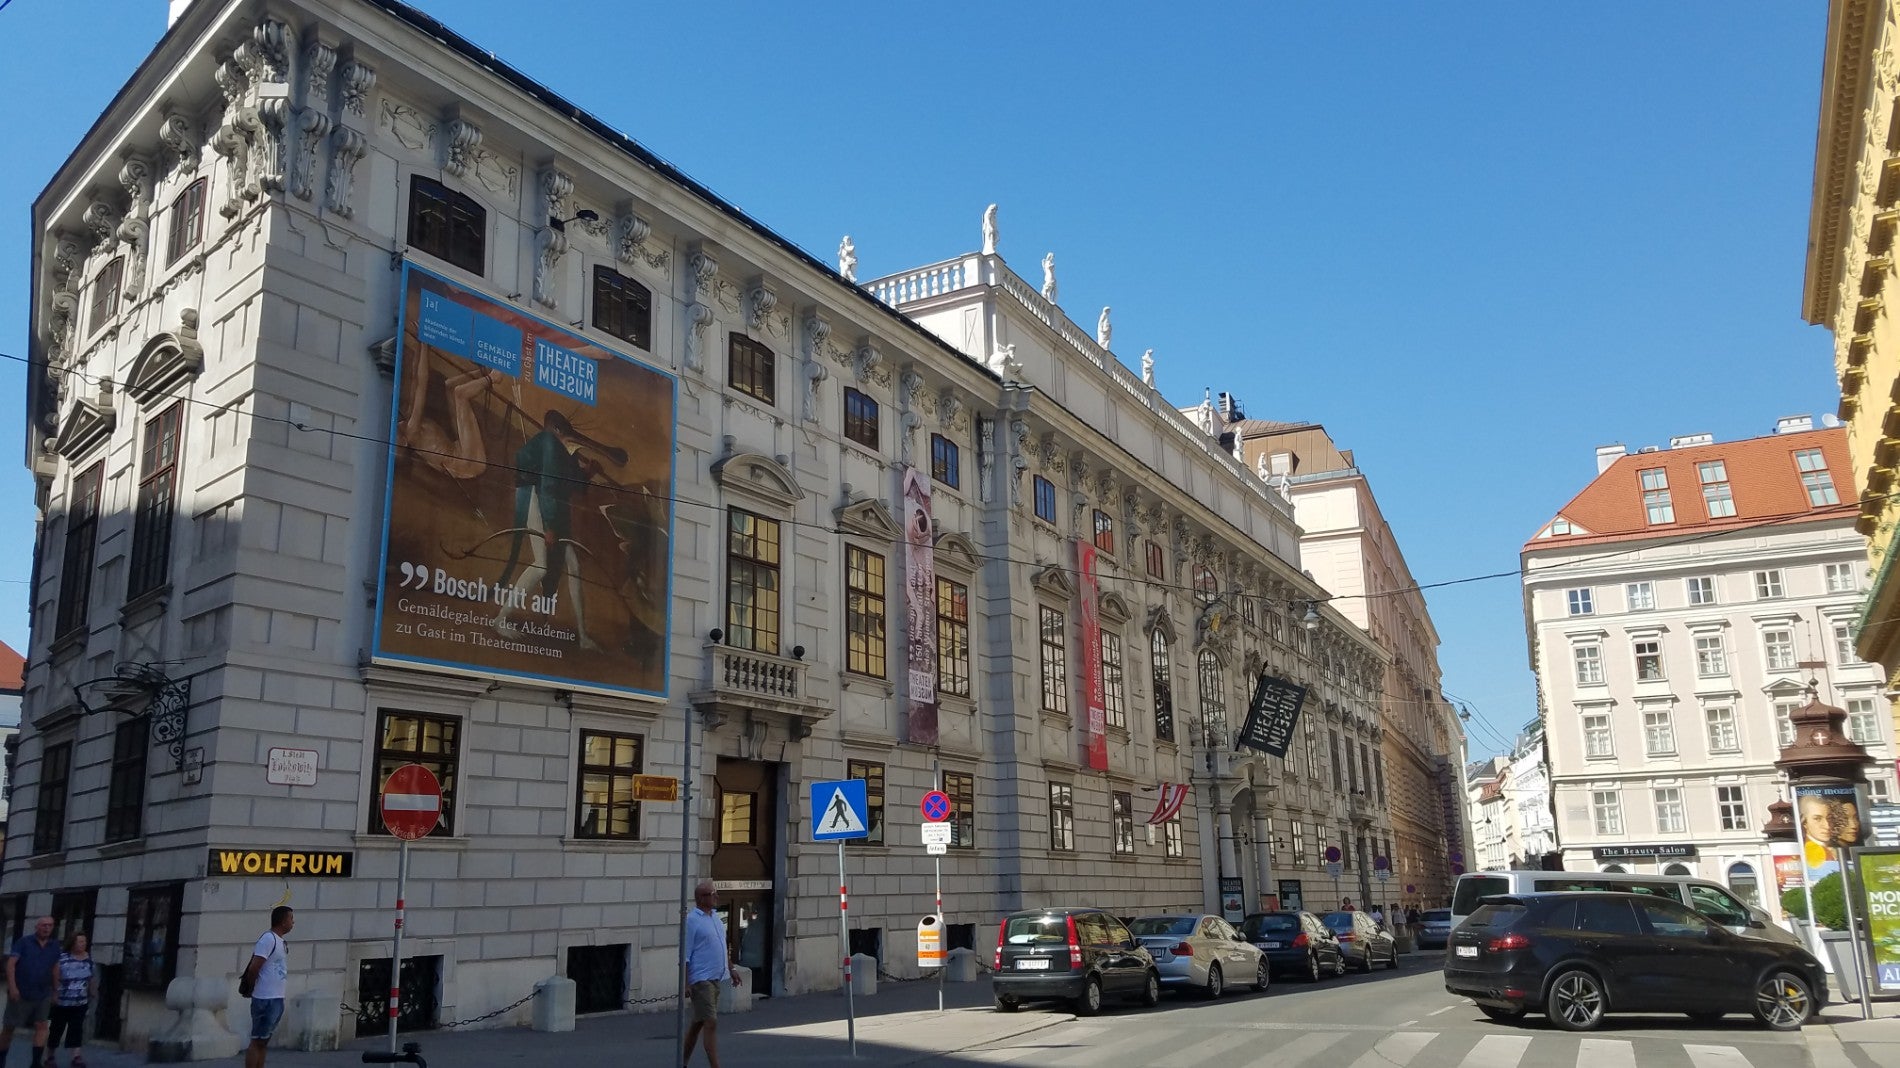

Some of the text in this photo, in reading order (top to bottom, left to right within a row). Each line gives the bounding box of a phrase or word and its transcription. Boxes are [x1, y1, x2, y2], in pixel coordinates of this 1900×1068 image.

[477, 350, 512, 370] GALERIE
[538, 343, 594, 382] THEATER
[434, 568, 488, 603] Bosch
[494, 582, 527, 610] tritt
[531, 592, 558, 616] auf
[398, 598, 576, 641] Gemäldegalerie der Akademie
[396, 622, 562, 658] zu Gast im Theatermuseum
[1251, 684, 1283, 742] THEATER
[220, 852, 342, 874] WOLFRUM
